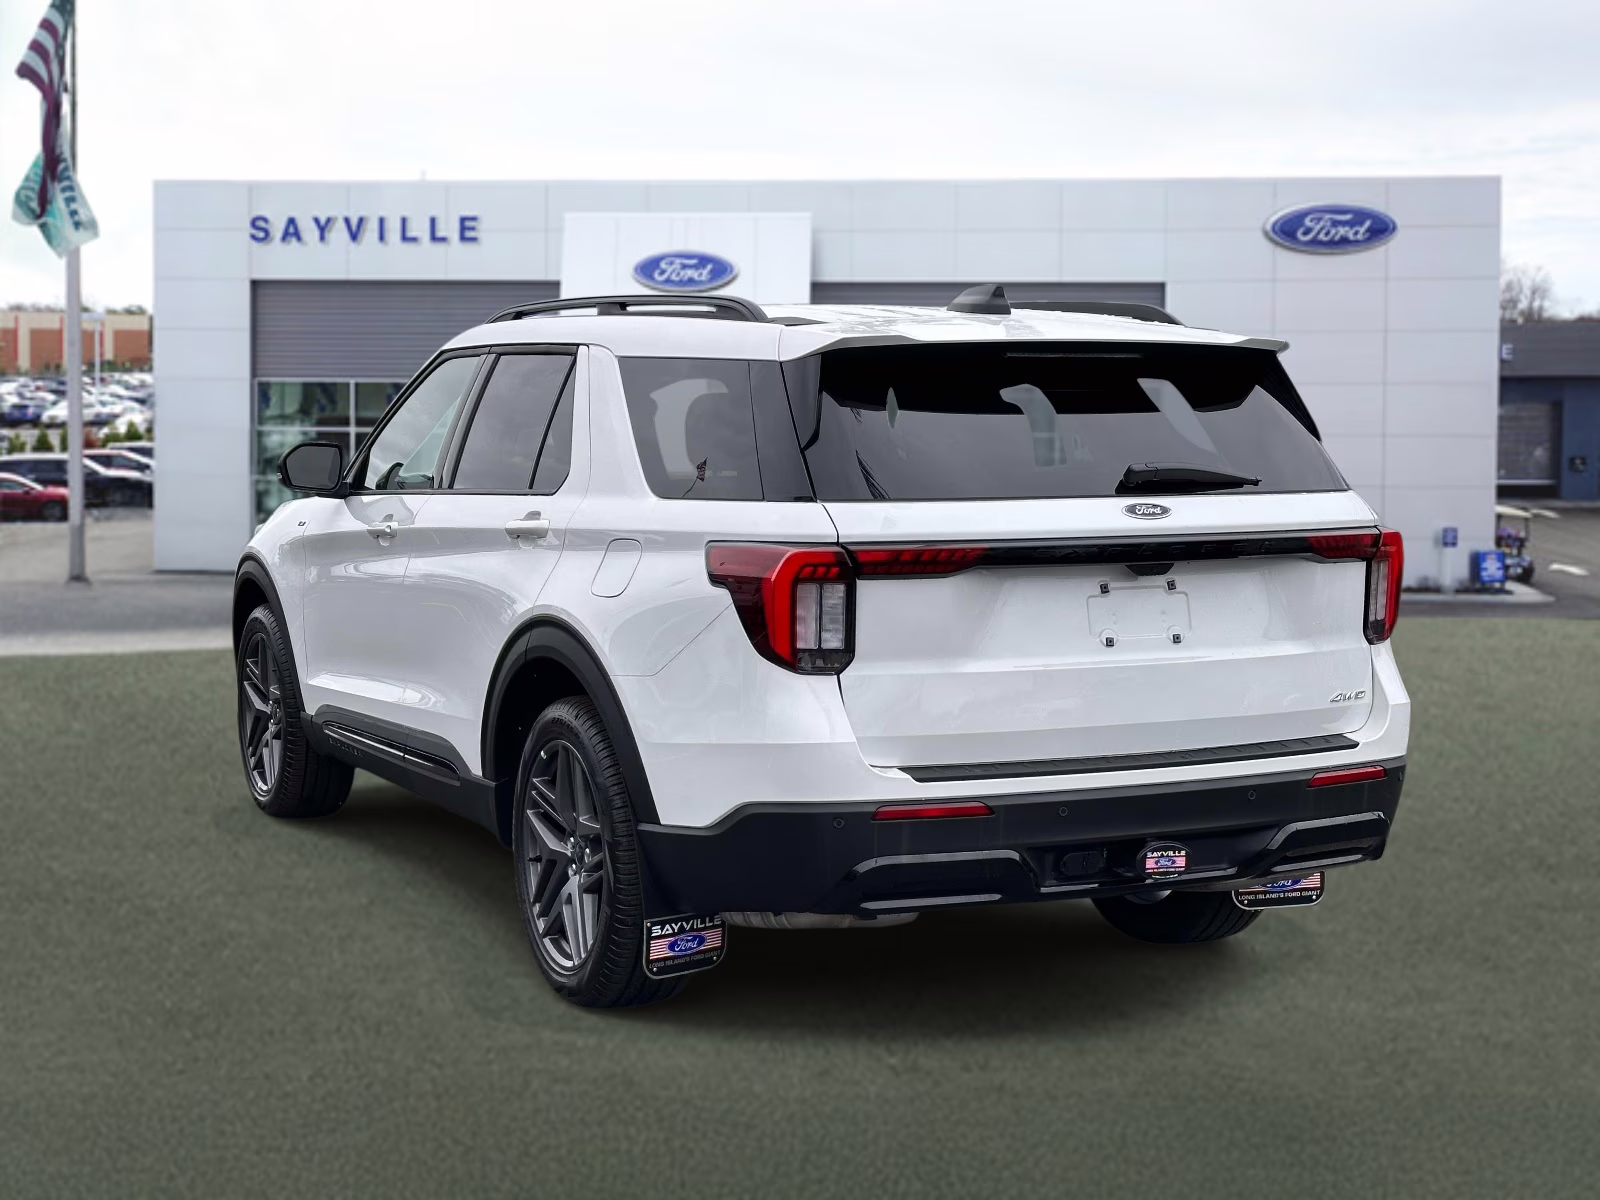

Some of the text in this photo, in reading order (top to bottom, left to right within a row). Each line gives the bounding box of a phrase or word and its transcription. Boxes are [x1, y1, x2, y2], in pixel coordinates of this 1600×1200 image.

[250, 215, 479, 243] SAYVILLE
[1297, 211, 1371, 241] Ford
[655, 257, 713, 281] Ford
[1135, 504, 1163, 515] Ford
[651, 915, 721, 936] SAYVILLE
[675, 936, 699, 951] Ford
[665, 957, 690, 965] ISLAND'S
